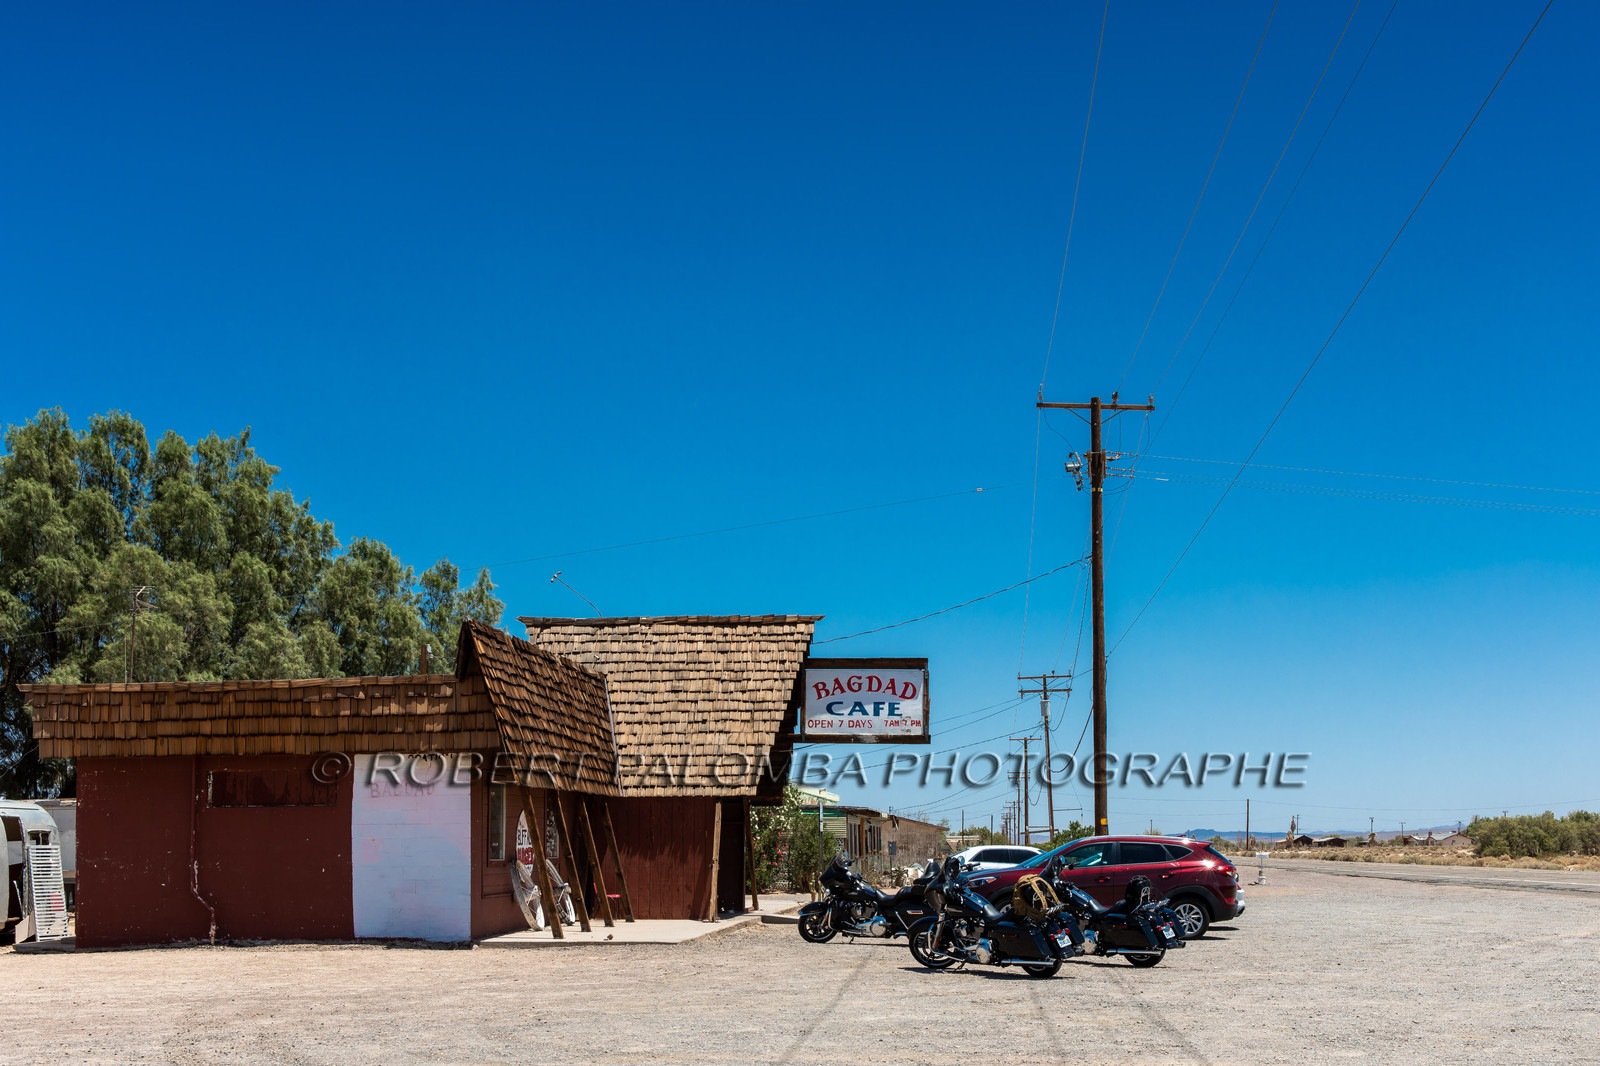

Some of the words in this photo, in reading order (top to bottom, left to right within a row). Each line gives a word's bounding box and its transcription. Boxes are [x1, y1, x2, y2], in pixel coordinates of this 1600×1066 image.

[812, 675, 917, 700] BAGDAD
[825, 701, 903, 717] CAFE
[807, 719, 833, 728] OPEN
[838, 719, 844, 728] 7
[847, 719, 873, 729] DAYS
[910, 719, 922, 727] PM
